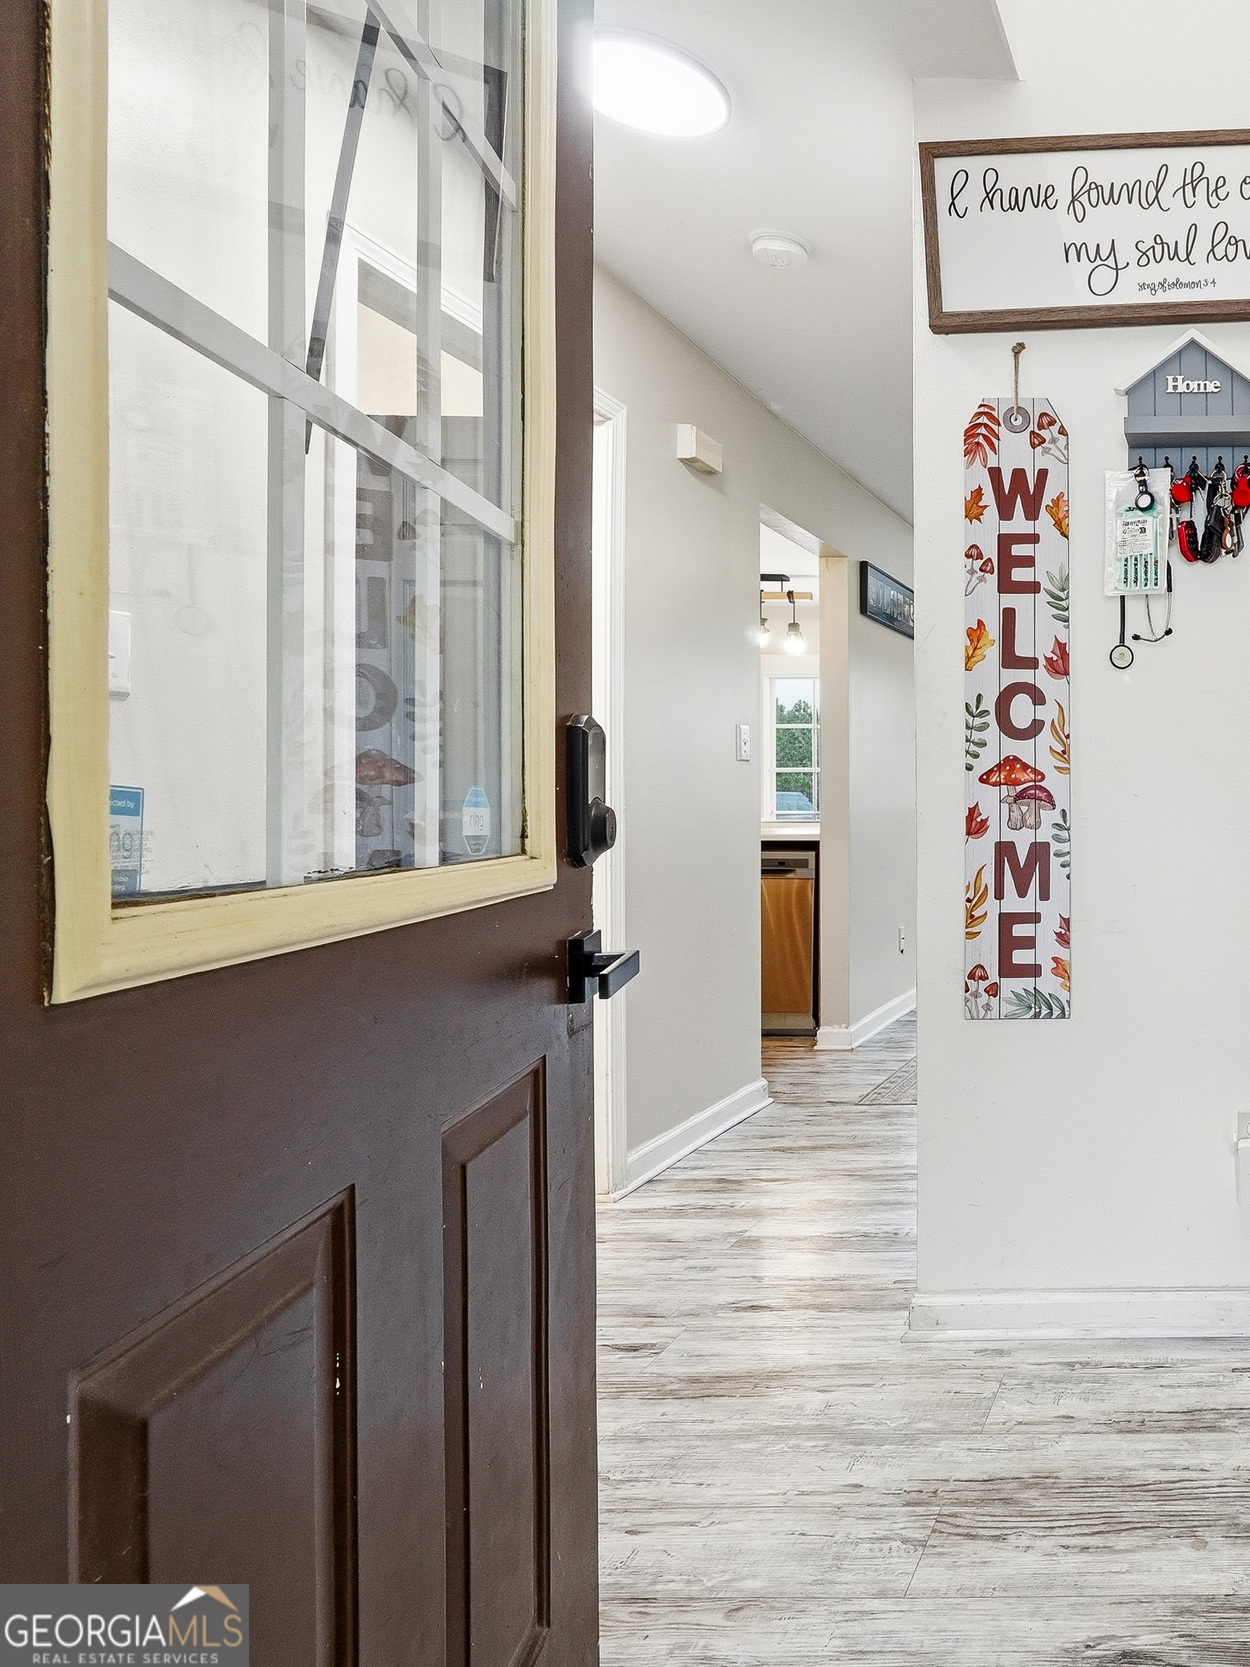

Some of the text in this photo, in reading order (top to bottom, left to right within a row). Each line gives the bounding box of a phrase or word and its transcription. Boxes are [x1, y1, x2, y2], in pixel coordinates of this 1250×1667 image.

[948, 169, 969, 219] I
[980, 168, 1059, 213] have
[1067, 163, 1170, 223] found
[1173, 161, 1230, 209] the
[1064, 238, 1129, 296] my
[1135, 223, 1197, 267] soul
[1166, 375, 1221, 393] Home
[987, 466, 1051, 979] WELCME
